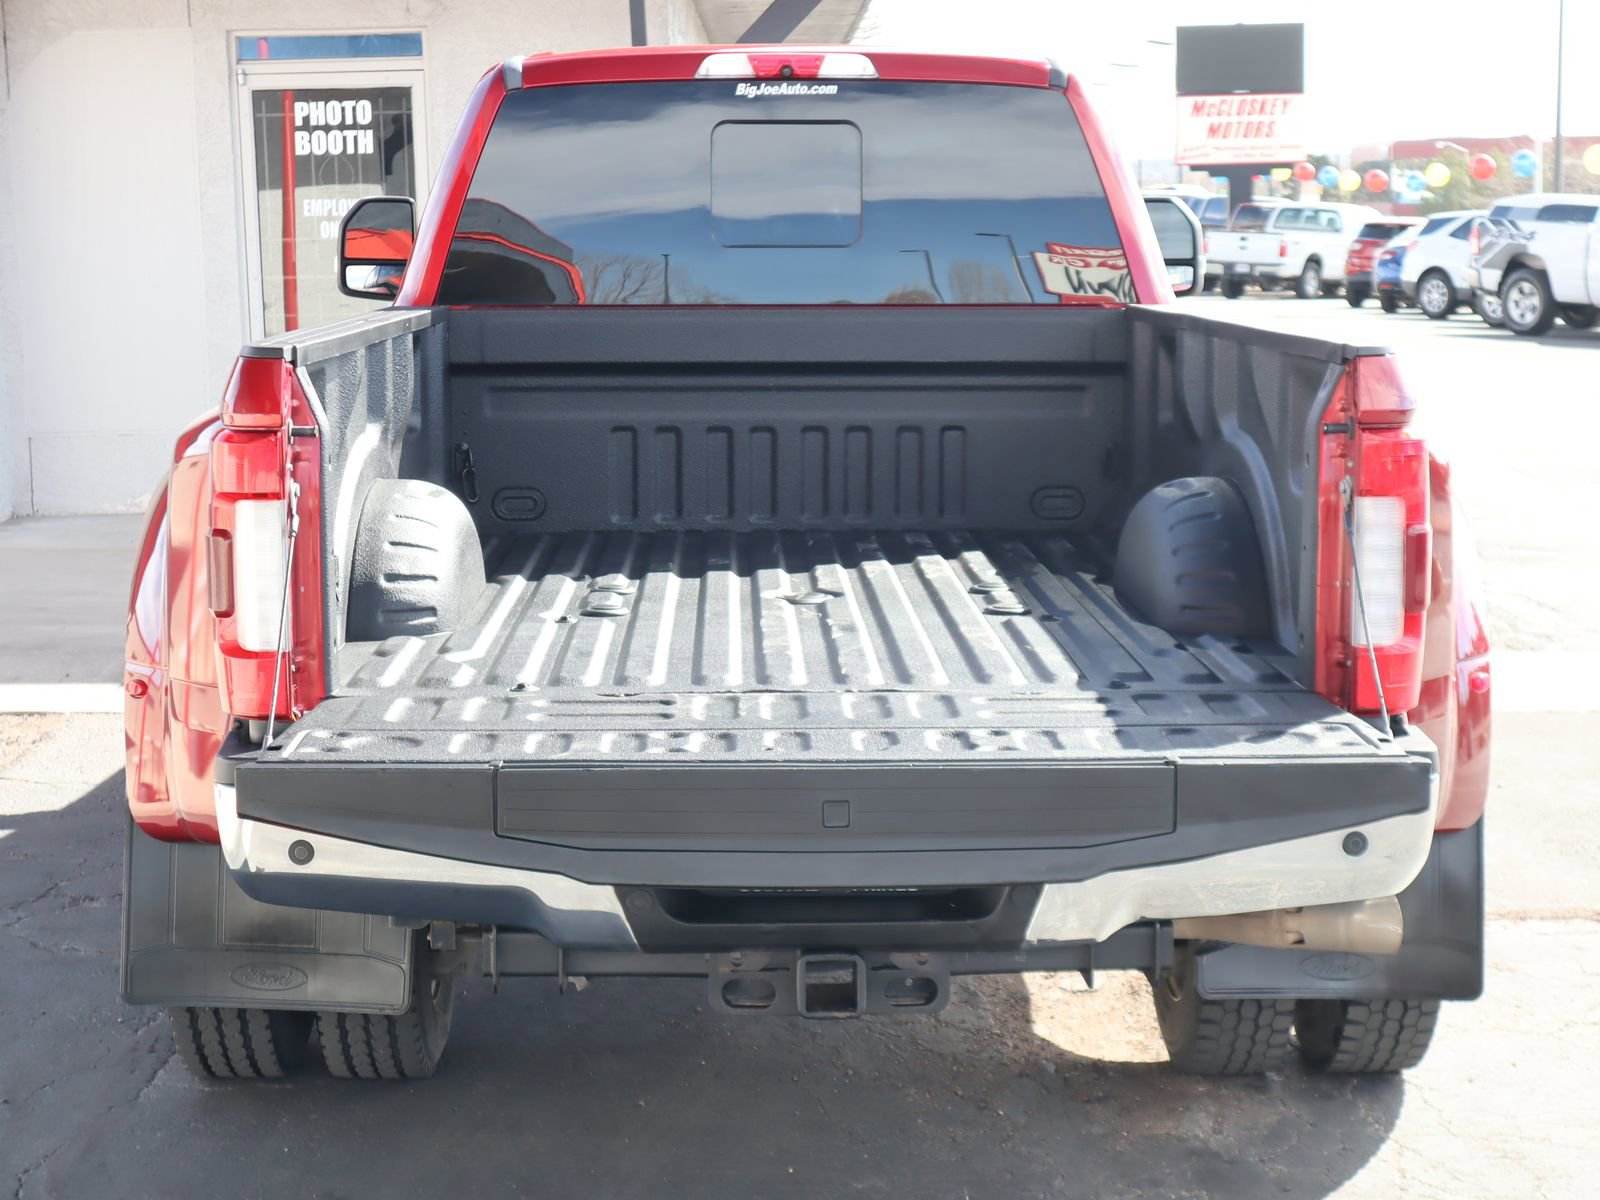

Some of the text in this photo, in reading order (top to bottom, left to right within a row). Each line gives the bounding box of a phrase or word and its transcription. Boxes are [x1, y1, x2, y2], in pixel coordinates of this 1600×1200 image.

[735, 82, 838, 99] BigJoeAuto.com
[294, 99, 373, 126] PHOTO
[1206, 120, 1276, 139] MOTORS
[294, 129, 375, 156] BOOTH
[320, 220, 340, 239] ON
